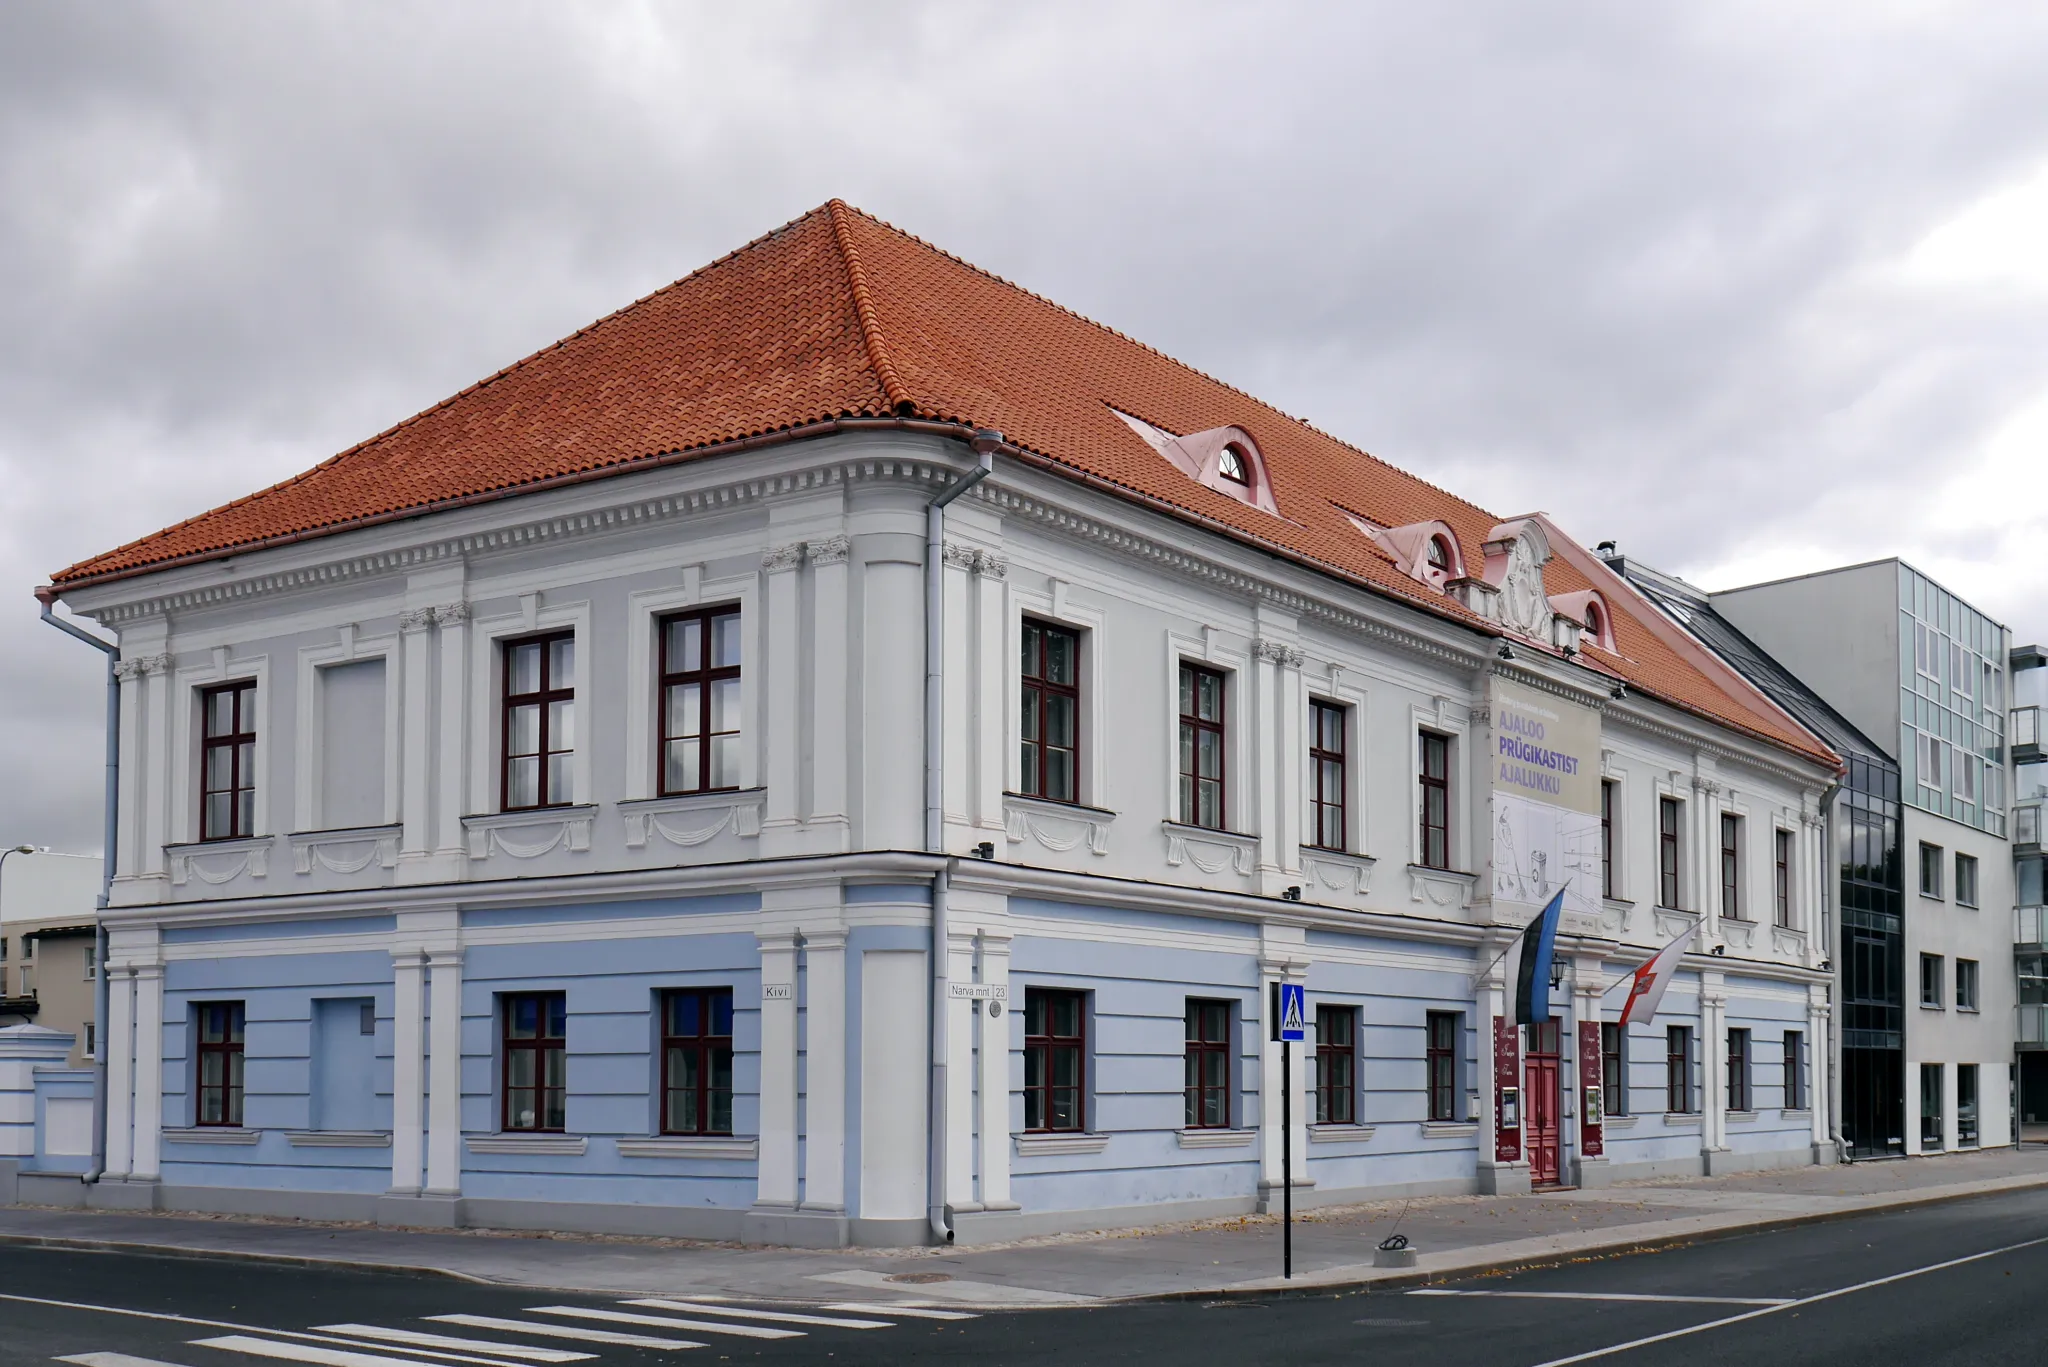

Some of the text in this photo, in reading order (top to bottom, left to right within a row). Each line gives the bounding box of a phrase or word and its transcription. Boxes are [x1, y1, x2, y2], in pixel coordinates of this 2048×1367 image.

[1500, 710, 1544, 740] AJALOO
[1500, 736, 1578, 775] PRÜGIKASTIST
[1500, 762, 1560, 795] AJALUKKU
[766, 986, 788, 997] Kivi
[952, 985, 990, 997] Narva mnt
[995, 987, 1005, 998] 23
